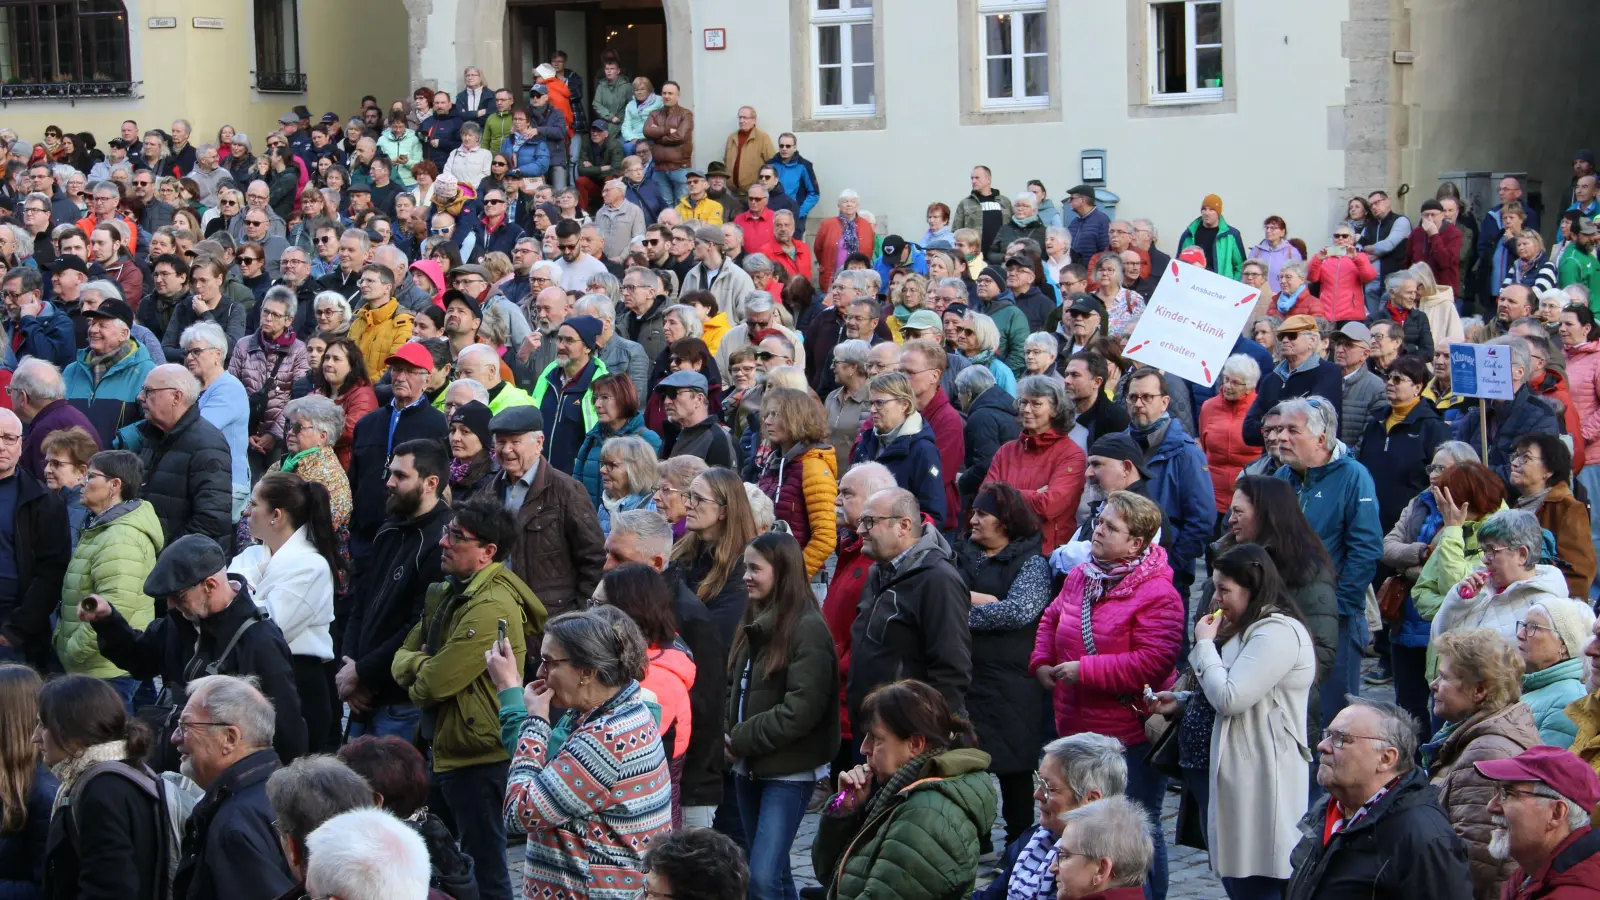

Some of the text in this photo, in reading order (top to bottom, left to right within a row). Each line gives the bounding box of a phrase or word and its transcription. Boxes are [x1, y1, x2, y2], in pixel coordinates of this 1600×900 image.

[1190, 284, 1226, 300] Ansbacher
[1154, 304, 1189, 324] Kinder
[1159, 340, 1196, 359] erhalten
